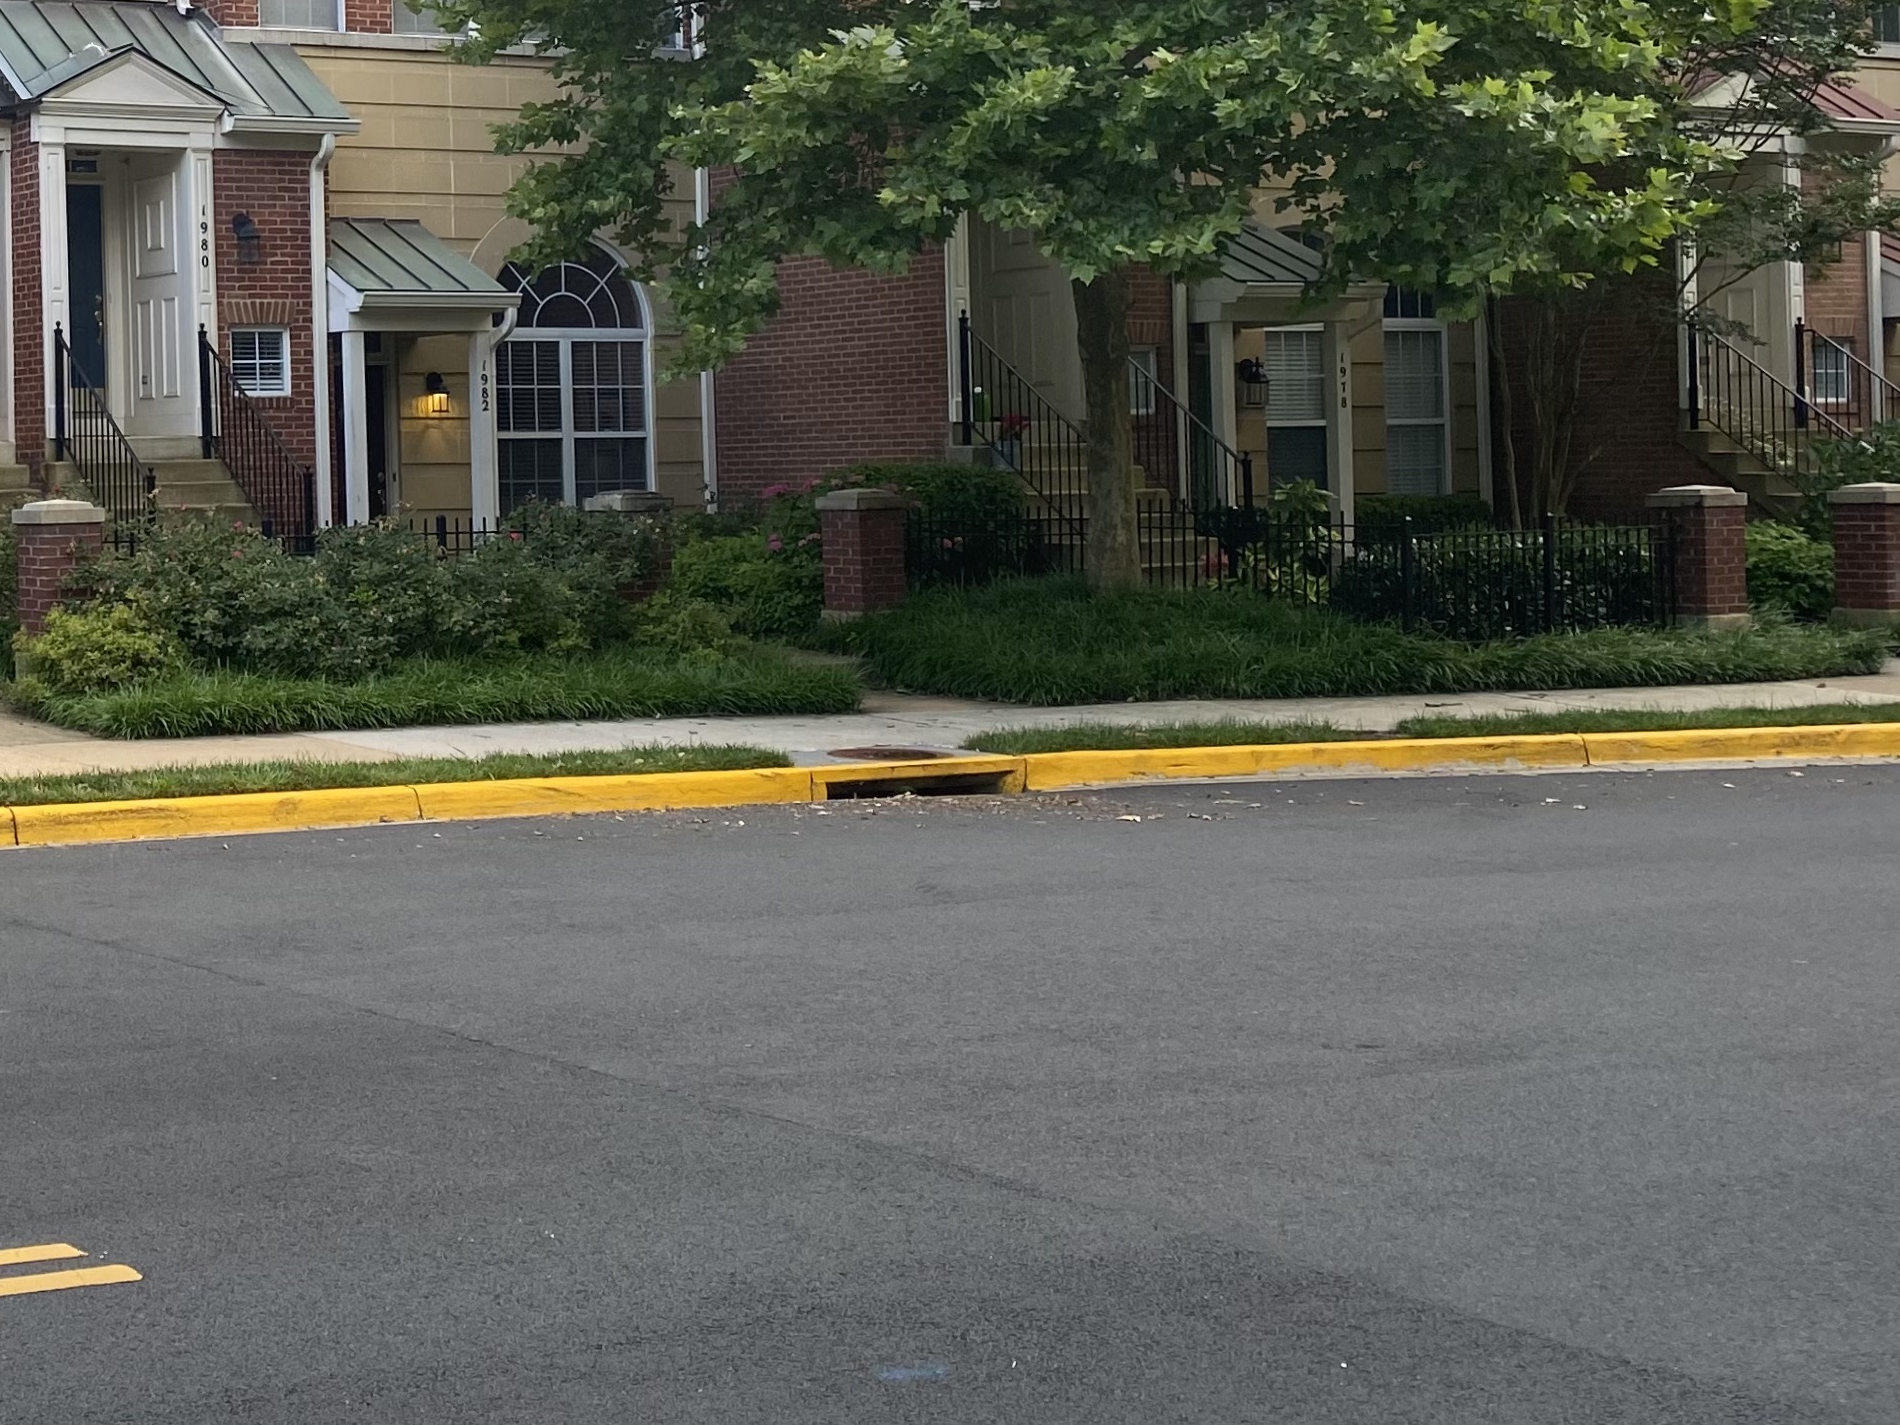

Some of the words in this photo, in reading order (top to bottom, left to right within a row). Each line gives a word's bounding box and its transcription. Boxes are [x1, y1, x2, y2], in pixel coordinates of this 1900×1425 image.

[200, 204, 209, 268] 1980
[480, 359, 490, 412] 1982
[1339, 352, 1347, 409] 1978
